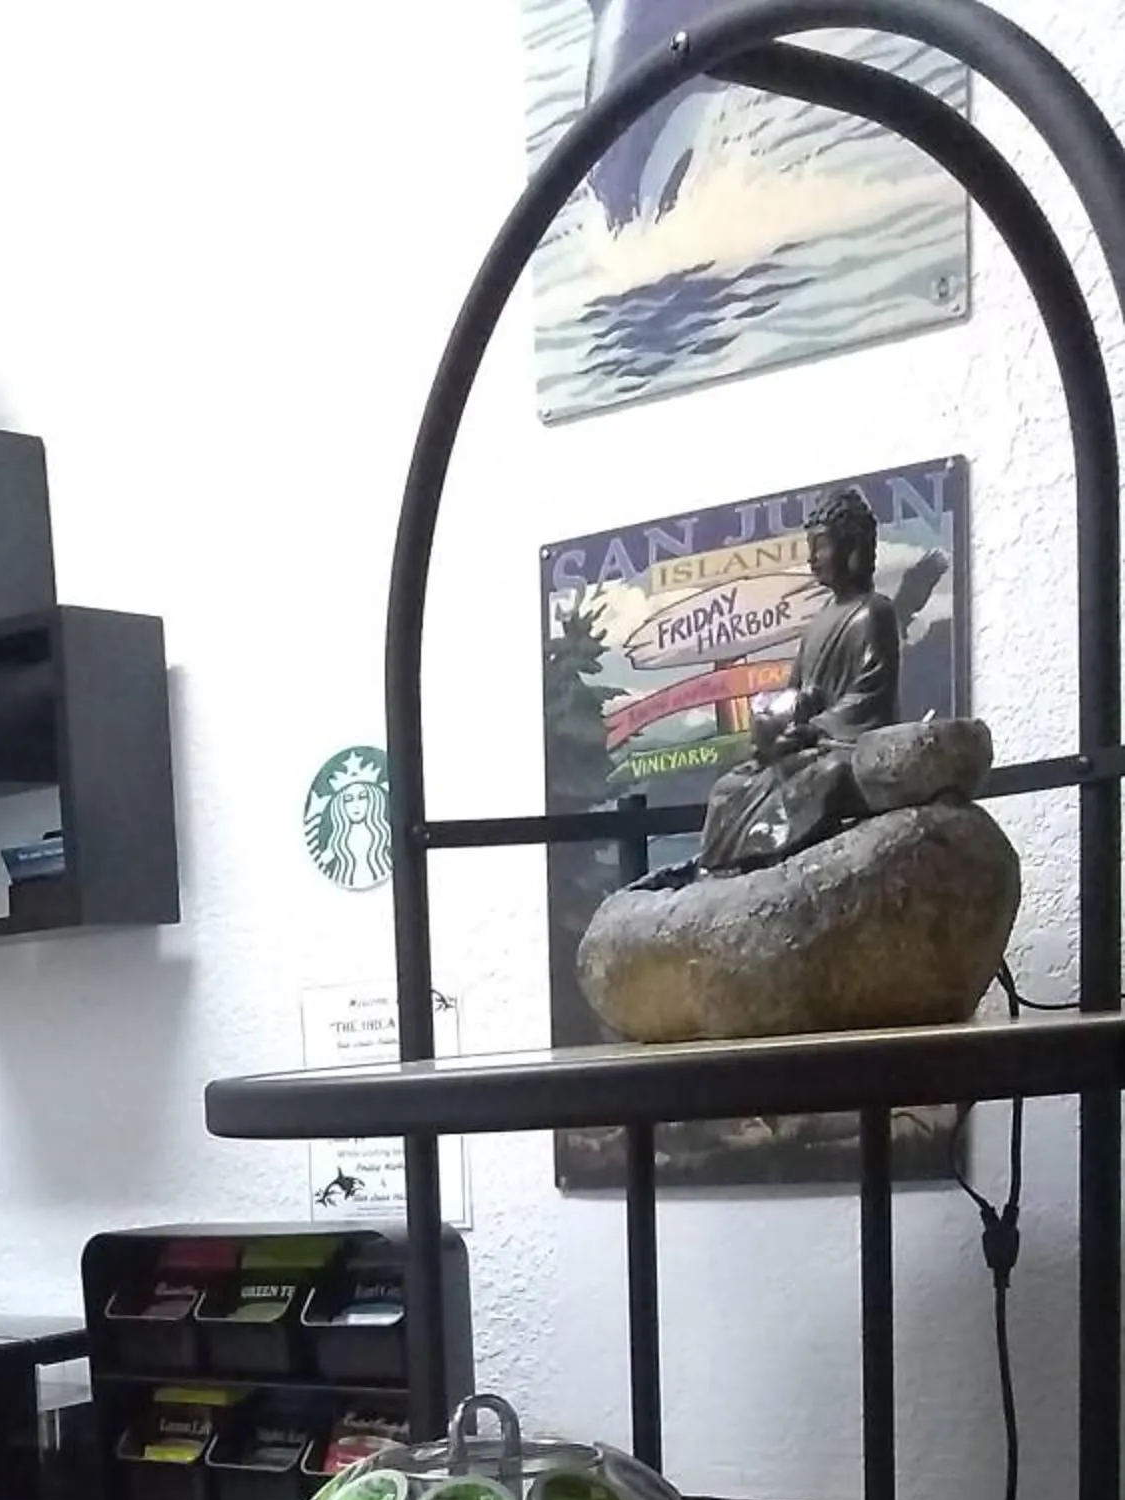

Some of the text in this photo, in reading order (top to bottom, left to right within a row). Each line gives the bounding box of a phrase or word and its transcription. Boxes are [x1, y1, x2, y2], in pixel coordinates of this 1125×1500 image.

[552, 517, 699, 598] SAN
[657, 587, 740, 650] FRIDAY
[697, 600, 793, 655] HARBOR
[630, 746, 719, 778] VINEYARDS
